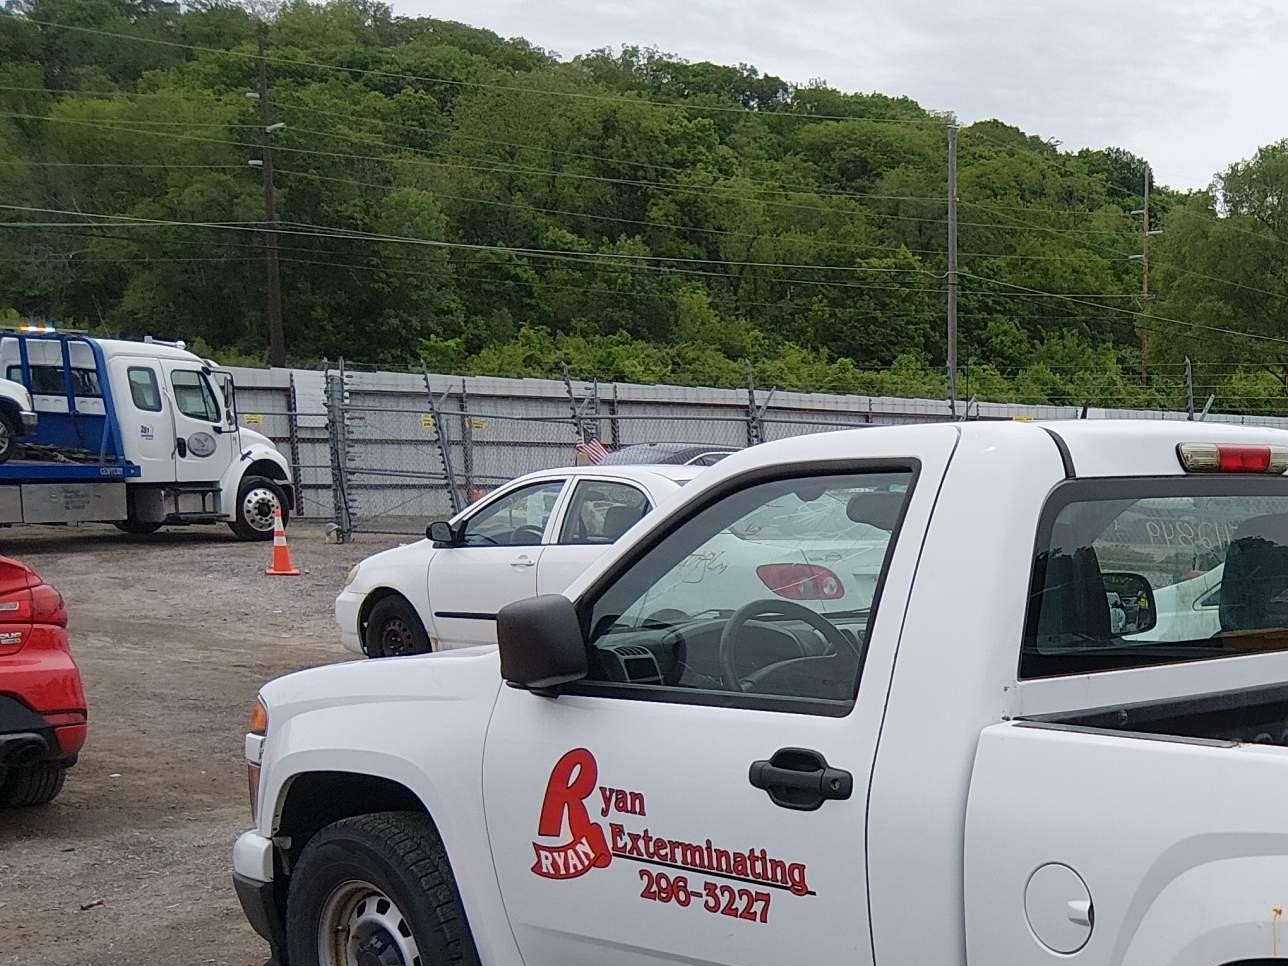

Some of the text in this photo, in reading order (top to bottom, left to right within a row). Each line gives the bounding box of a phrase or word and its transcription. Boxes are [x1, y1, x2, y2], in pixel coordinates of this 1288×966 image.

[538, 747, 646, 868] Ryan
[539, 836, 595, 875] RYAN
[609, 822, 809, 896] Exterminating
[638, 868, 771, 924] 296-3227
